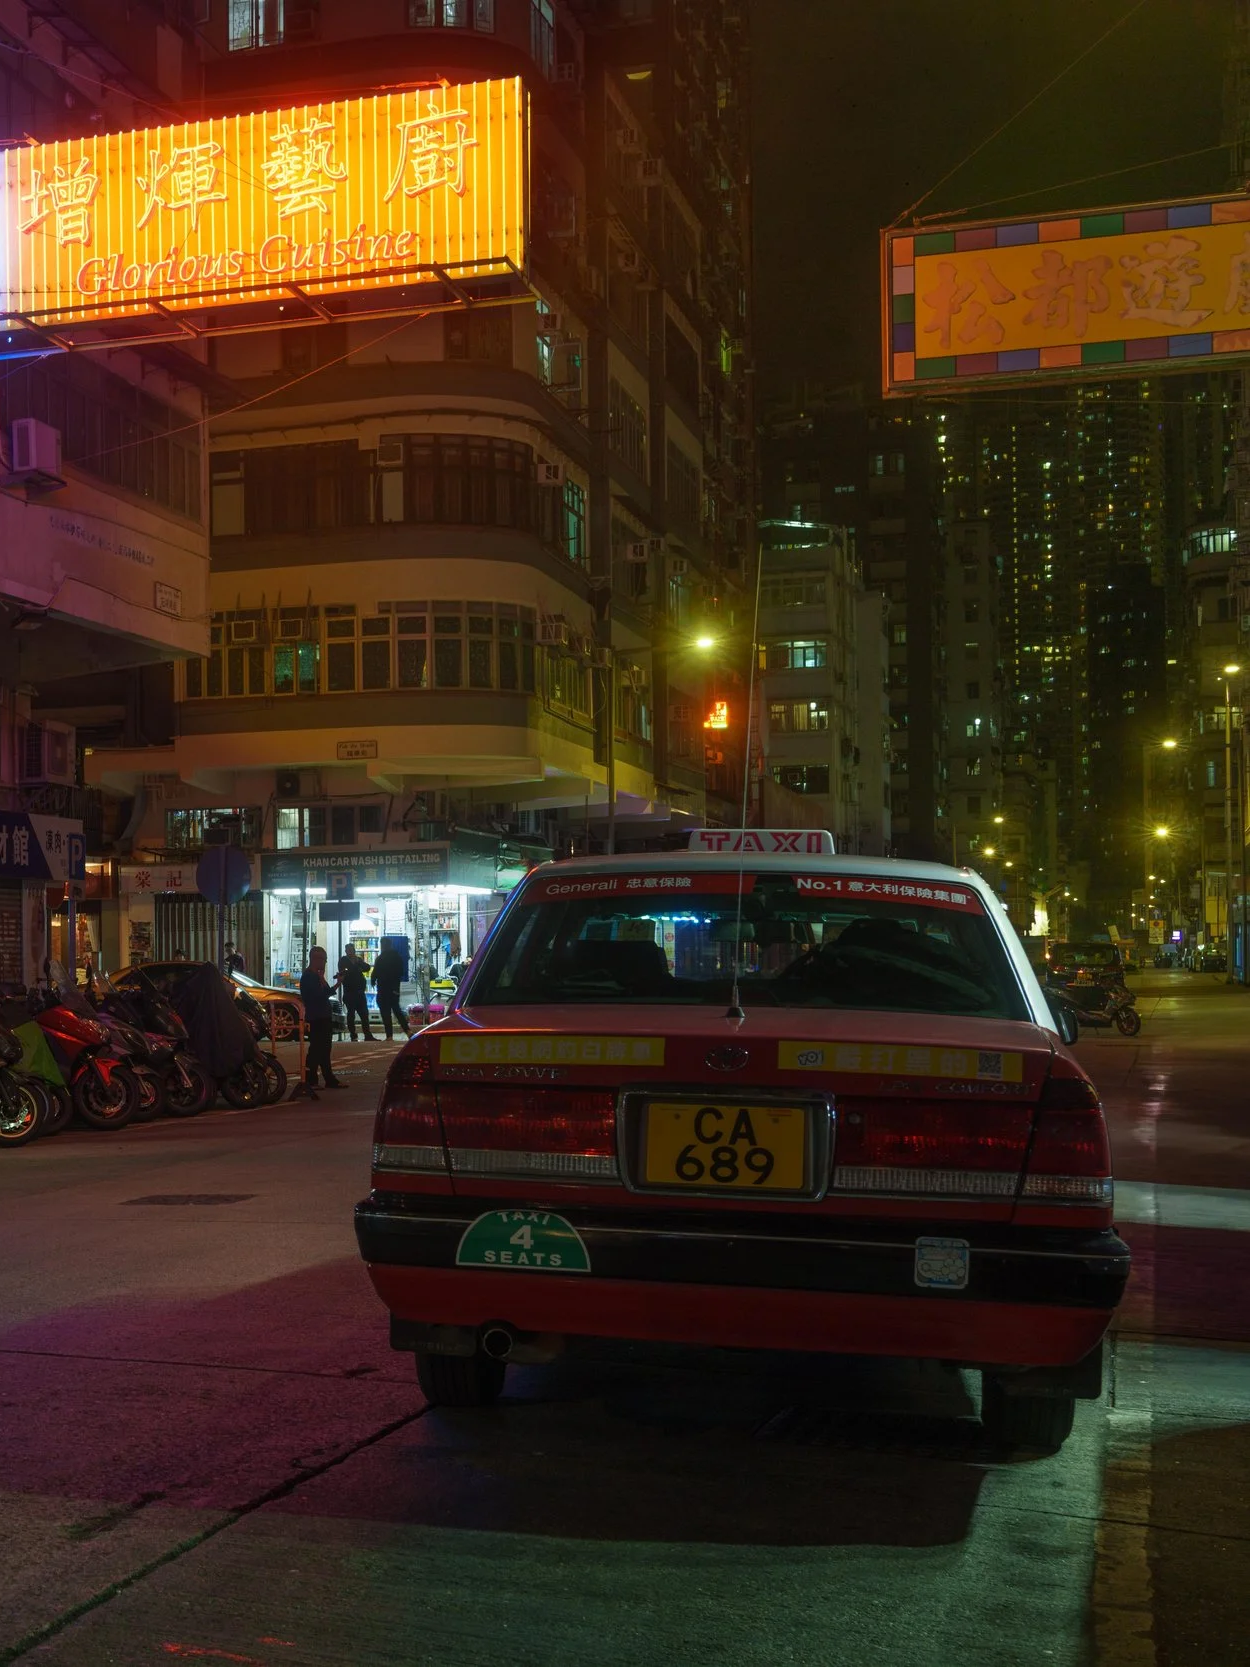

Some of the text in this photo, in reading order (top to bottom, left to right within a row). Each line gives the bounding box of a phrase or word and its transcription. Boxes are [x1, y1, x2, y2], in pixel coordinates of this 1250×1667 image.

[75, 223, 416, 298] Glorious Cuisine
[699, 831, 822, 853] TAXI
[303, 857, 329, 867] KHAN
[330, 856, 350, 866] CAR
[350, 855, 379, 866] WASH
[385, 853, 441, 865] DETAILING
[546, 876, 692, 896] Generali 忠意保險
[796, 877, 967, 905] No.1 意大利保險集團
[694, 1107, 757, 1146] CA
[675, 1144, 775, 1185] 689
[497, 1211, 551, 1225] TAXI
[509, 1224, 534, 1250] 4
[484, 1250, 562, 1267] SEATS
